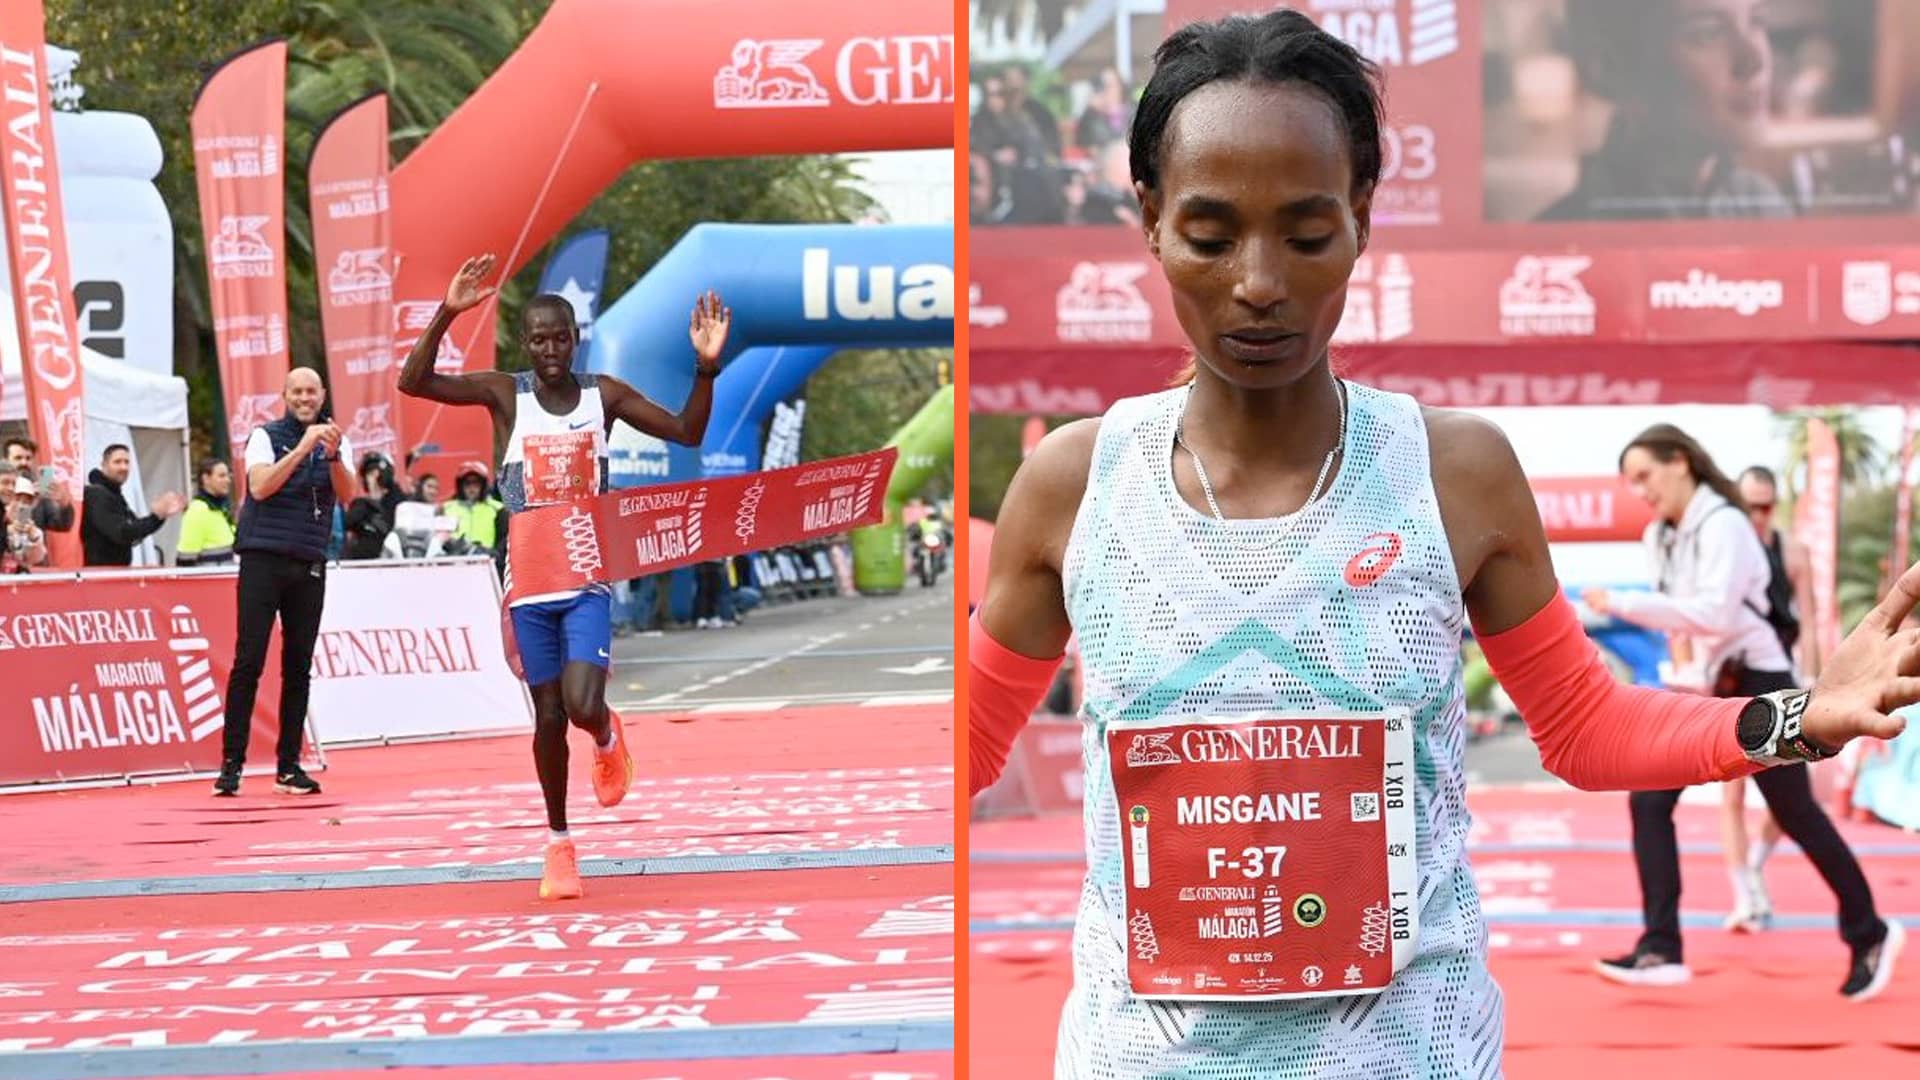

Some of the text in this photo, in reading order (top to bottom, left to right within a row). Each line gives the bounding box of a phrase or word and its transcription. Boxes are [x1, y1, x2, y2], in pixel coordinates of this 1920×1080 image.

[1, 41, 76, 390] GENERALI
[631, 490, 690, 513] GENERALI
[803, 497, 853, 532] MÁLAGA
[636, 529, 689, 566] MÁLAGA
[12, 608, 157, 649] GENERALI
[94, 657, 166, 687] MARATÓN
[31, 683, 187, 752] MÁLAGA
[1181, 725, 1363, 763] GENERALI
[1386, 760, 1404, 808] BOX 1
[1176, 792, 1322, 825] MISGANE
[1207, 846, 1288, 880] F-37
[1388, 844, 1407, 857] 42K
[1196, 886, 1256, 900] GENERALI
[1198, 914, 1260, 939] MÁLAGA
[1392, 890, 1410, 940] BOX 1
